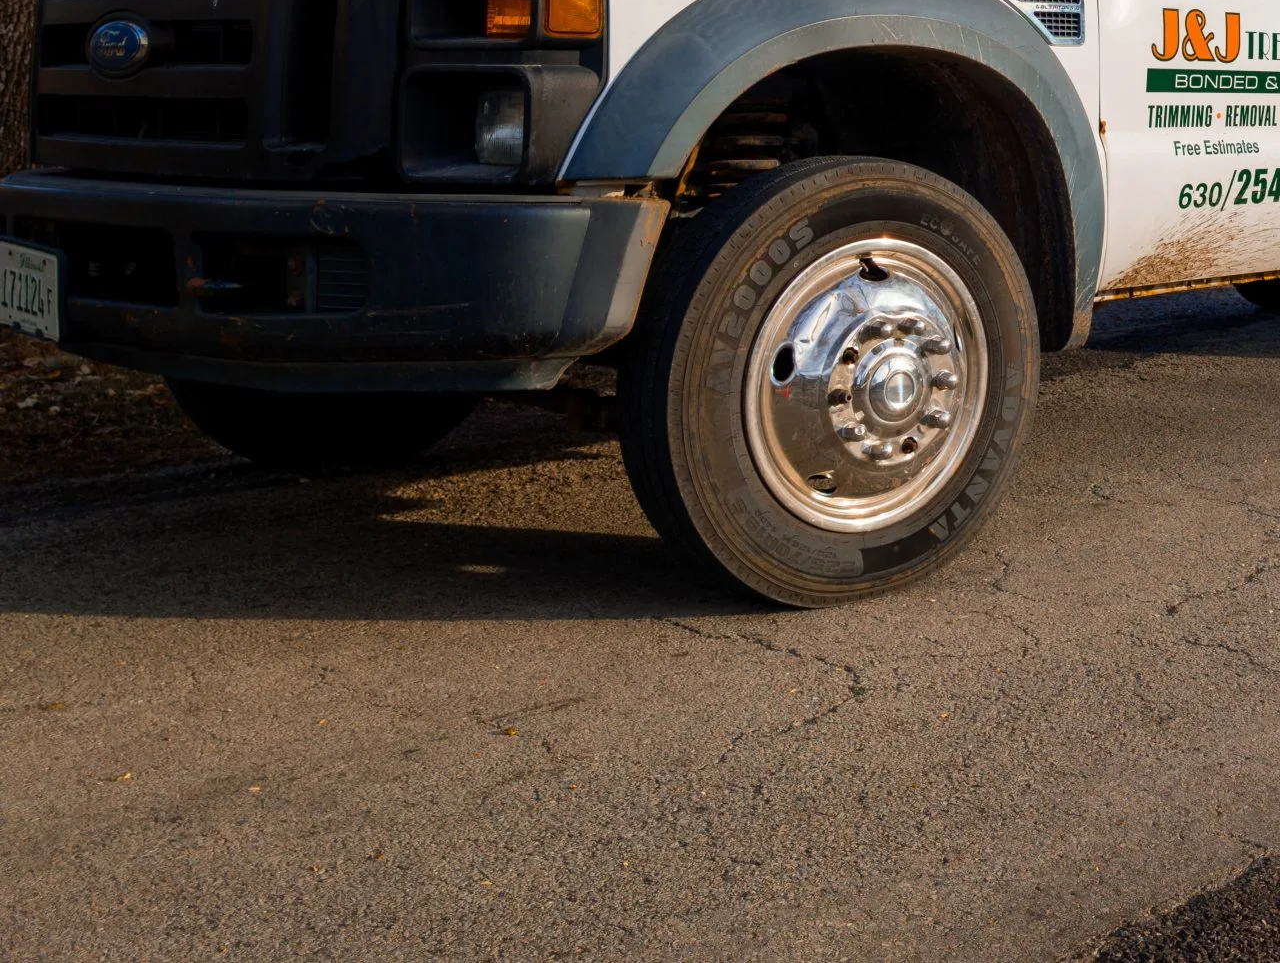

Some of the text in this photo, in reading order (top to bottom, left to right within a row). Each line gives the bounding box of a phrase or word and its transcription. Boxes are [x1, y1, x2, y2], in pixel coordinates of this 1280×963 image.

[96, 29, 128, 57] Ford
[1151, 7, 1241, 64] J&J
[1174, 74, 1259, 90] BONDED
[1265, 76, 1279, 90] &
[1148, 104, 1213, 129] TRIMMING
[1225, 104, 1278, 128] REMOVAL
[1174, 140, 1201, 156] Free
[1204, 139, 1260, 155] Estimates
[47, 288, 53, 314] F
